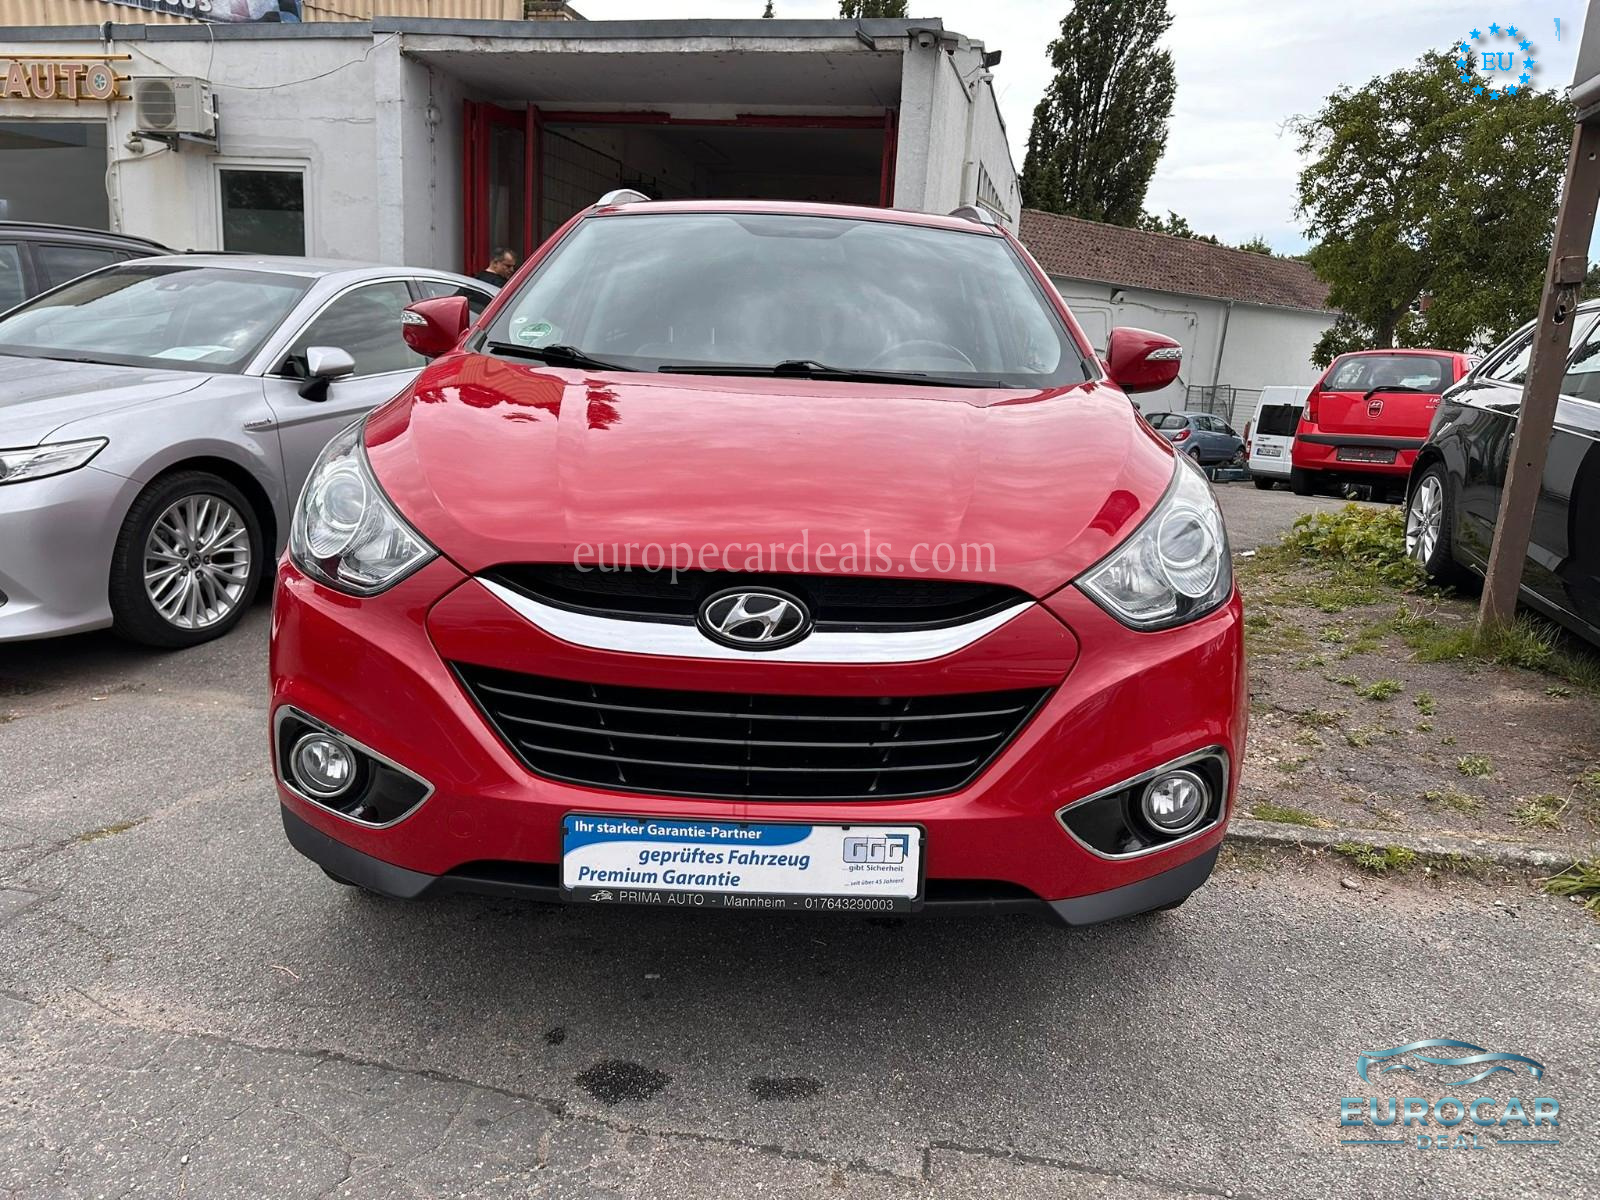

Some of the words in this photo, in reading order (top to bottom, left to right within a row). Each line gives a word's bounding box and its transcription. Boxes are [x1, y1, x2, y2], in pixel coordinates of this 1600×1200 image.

[3, 63, 115, 100] AUTO
[575, 820, 594, 833] Ihr
[597, 822, 644, 835] starker
[647, 824, 762, 840] Garantie-Partner
[639, 848, 724, 865] geprüftes
[728, 849, 811, 870] Fahrzeug
[866, 864, 904, 872] Sicherheit
[578, 865, 658, 884] Premium
[662, 869, 741, 887] Garantie
[619, 891, 662, 904] PRIMA
[668, 893, 705, 905] AUTO
[723, 895, 786, 908] Mannheim
[805, 897, 894, 910] 017643290003
